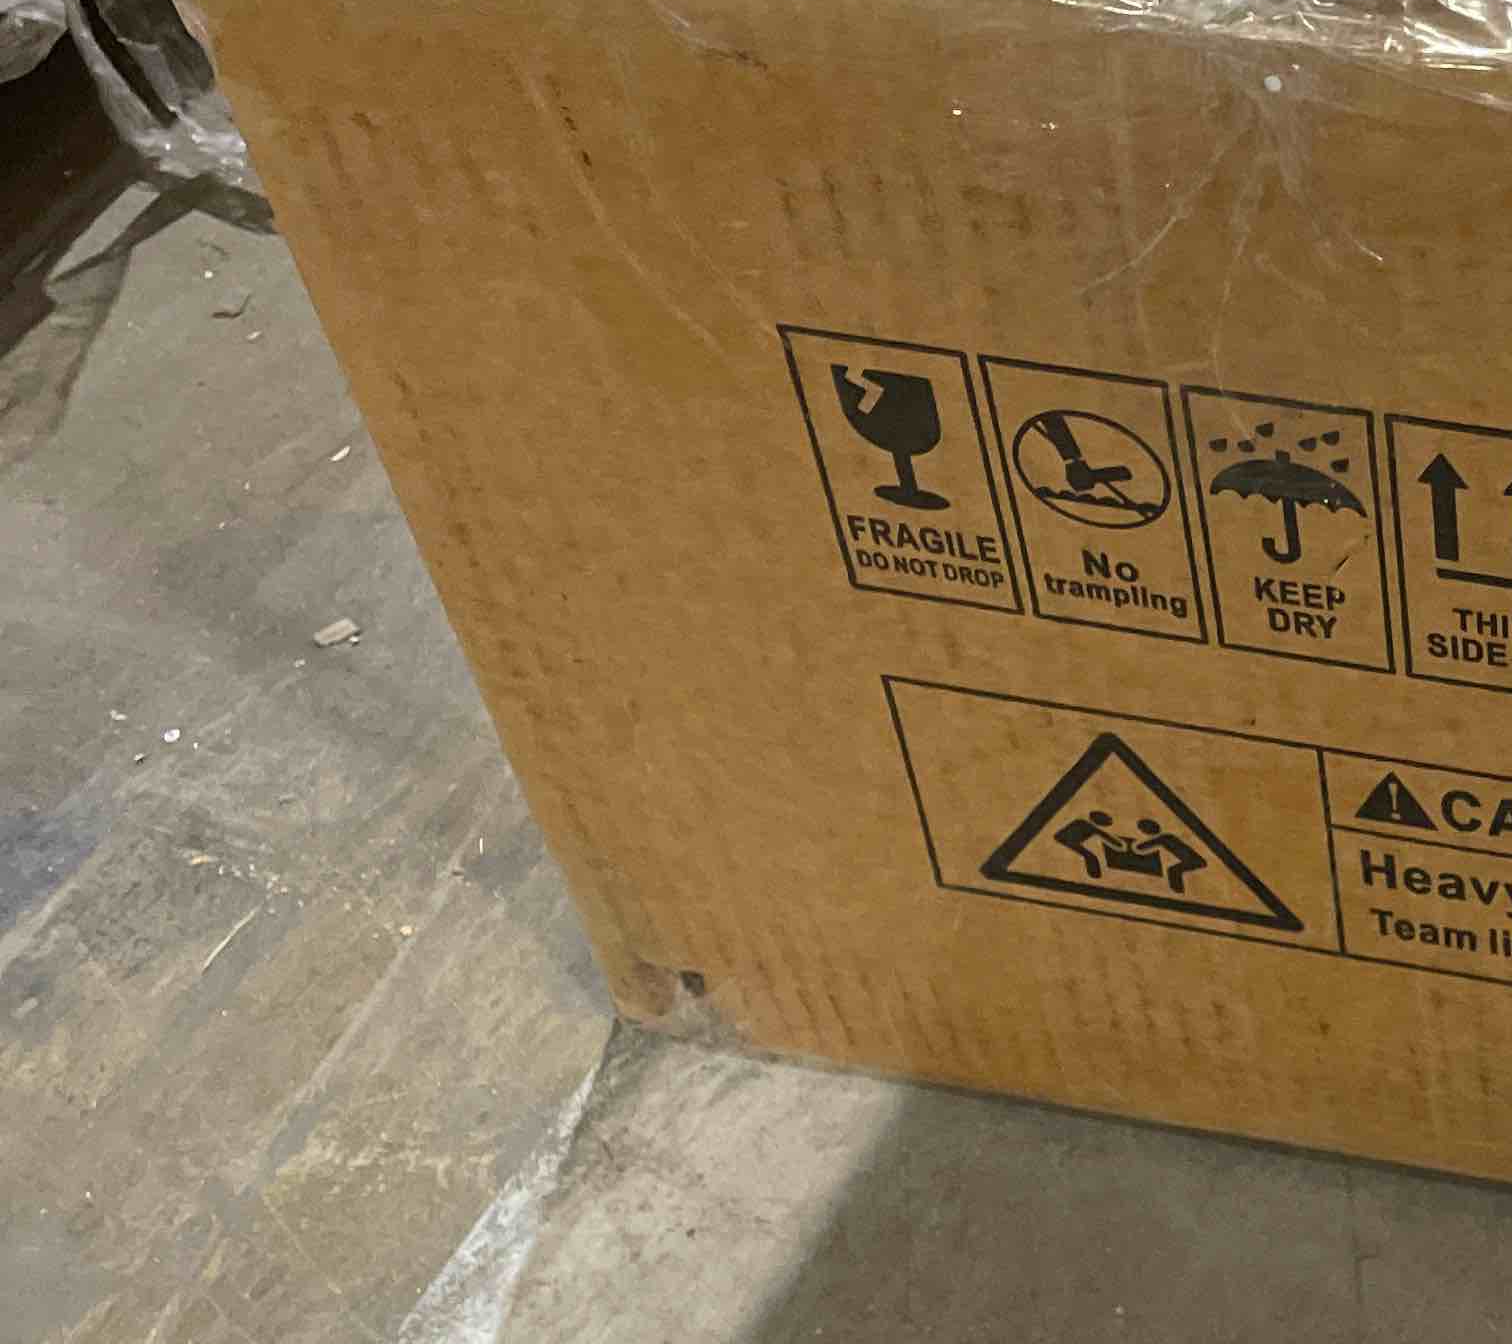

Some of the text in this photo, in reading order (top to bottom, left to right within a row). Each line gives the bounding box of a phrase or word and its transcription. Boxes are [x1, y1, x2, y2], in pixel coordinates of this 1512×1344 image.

[846, 513, 1001, 564] FRAGILE
[856, 548, 1006, 590] DO NOT DROP
[1081, 549, 1139, 581] No
[1044, 572, 1188, 619] trampling
[1254, 576, 1345, 610] KEEP
[1266, 607, 1338, 639] DRY
[1426, 632, 1511, 669] SIDE
[1370, 907, 1478, 953] Team
